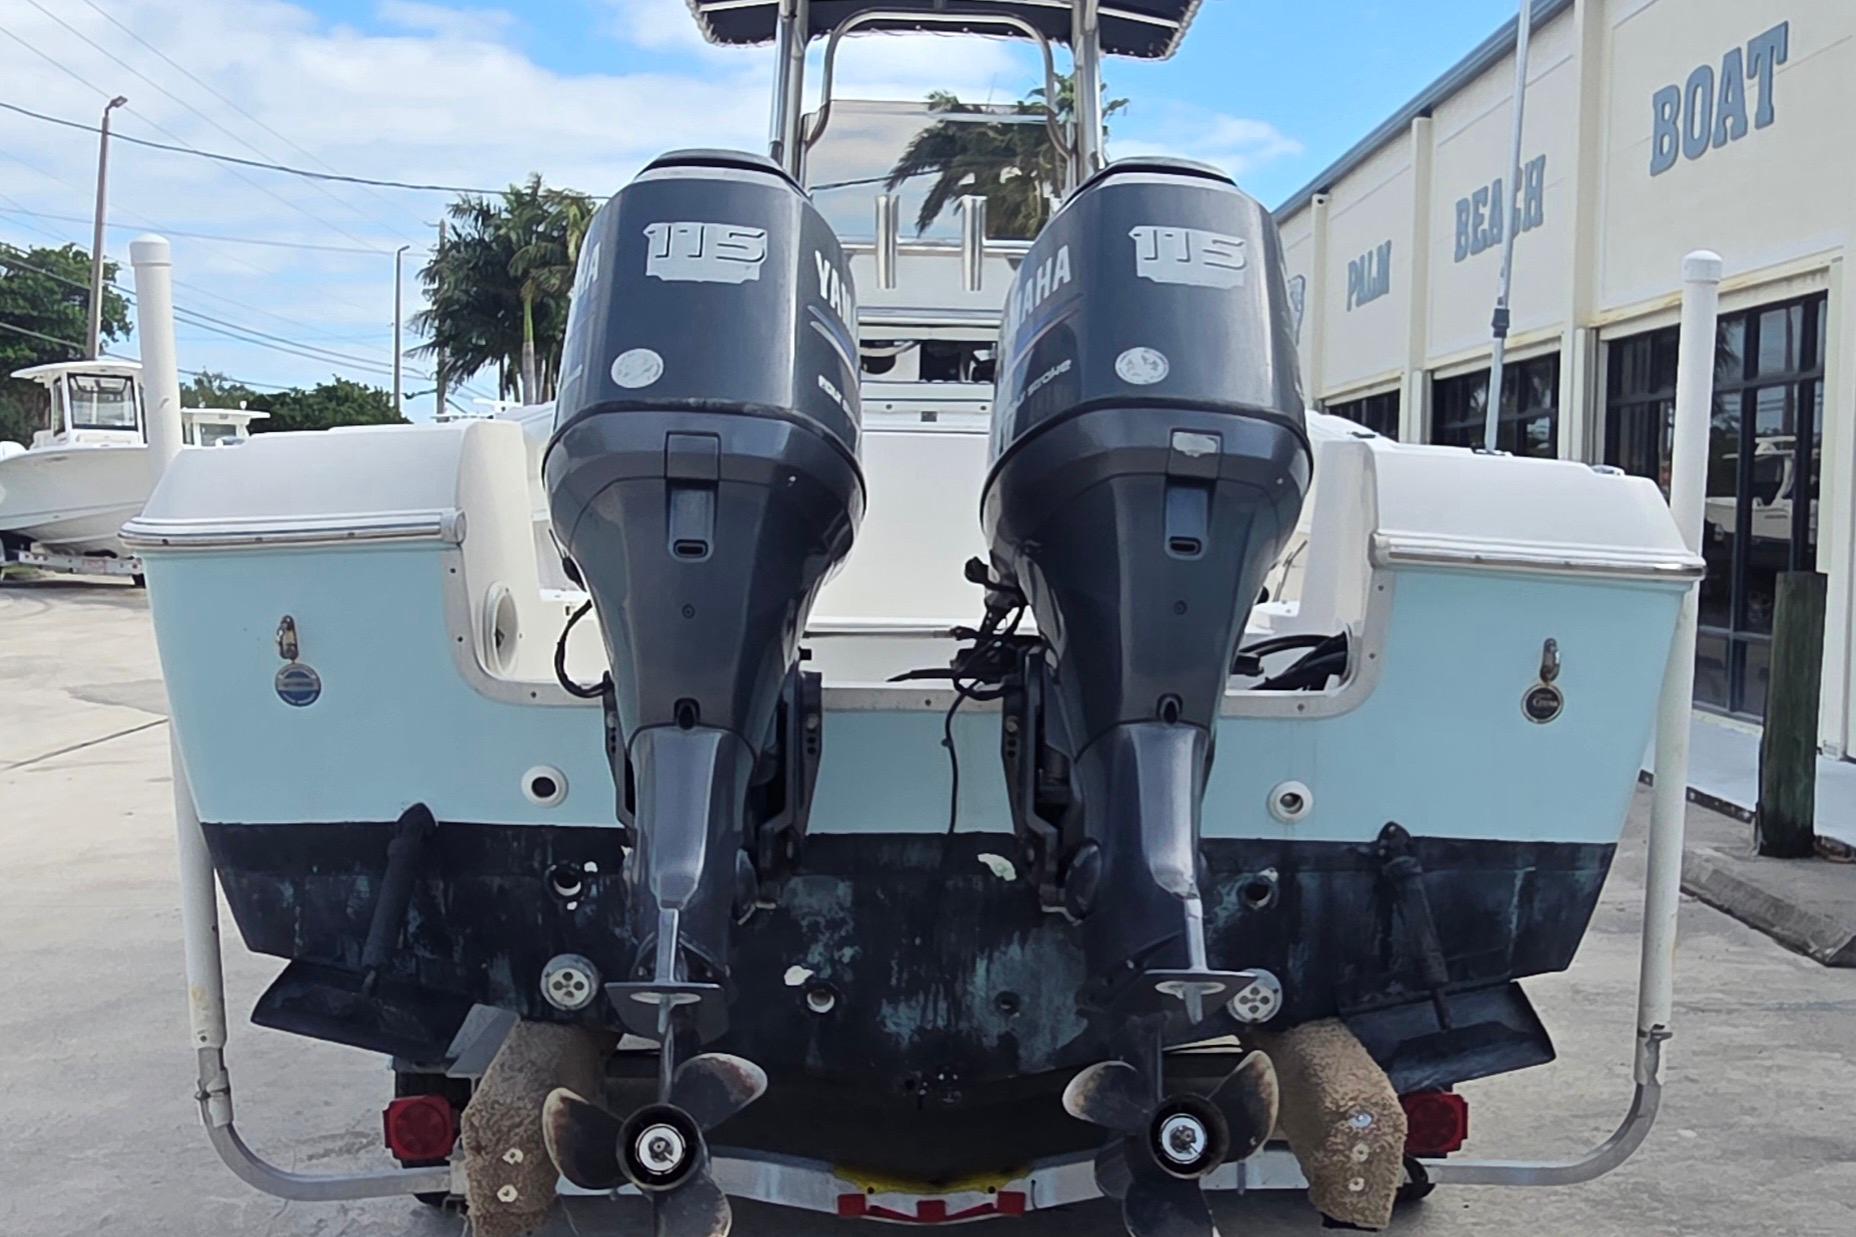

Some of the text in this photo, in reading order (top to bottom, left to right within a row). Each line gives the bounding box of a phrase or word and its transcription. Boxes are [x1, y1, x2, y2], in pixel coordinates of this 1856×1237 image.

[1346, 239, 1391, 312] PALM
[1650, 20, 1788, 177] BOAT
[643, 222, 768, 265] 115
[1128, 226, 1248, 271] 115
